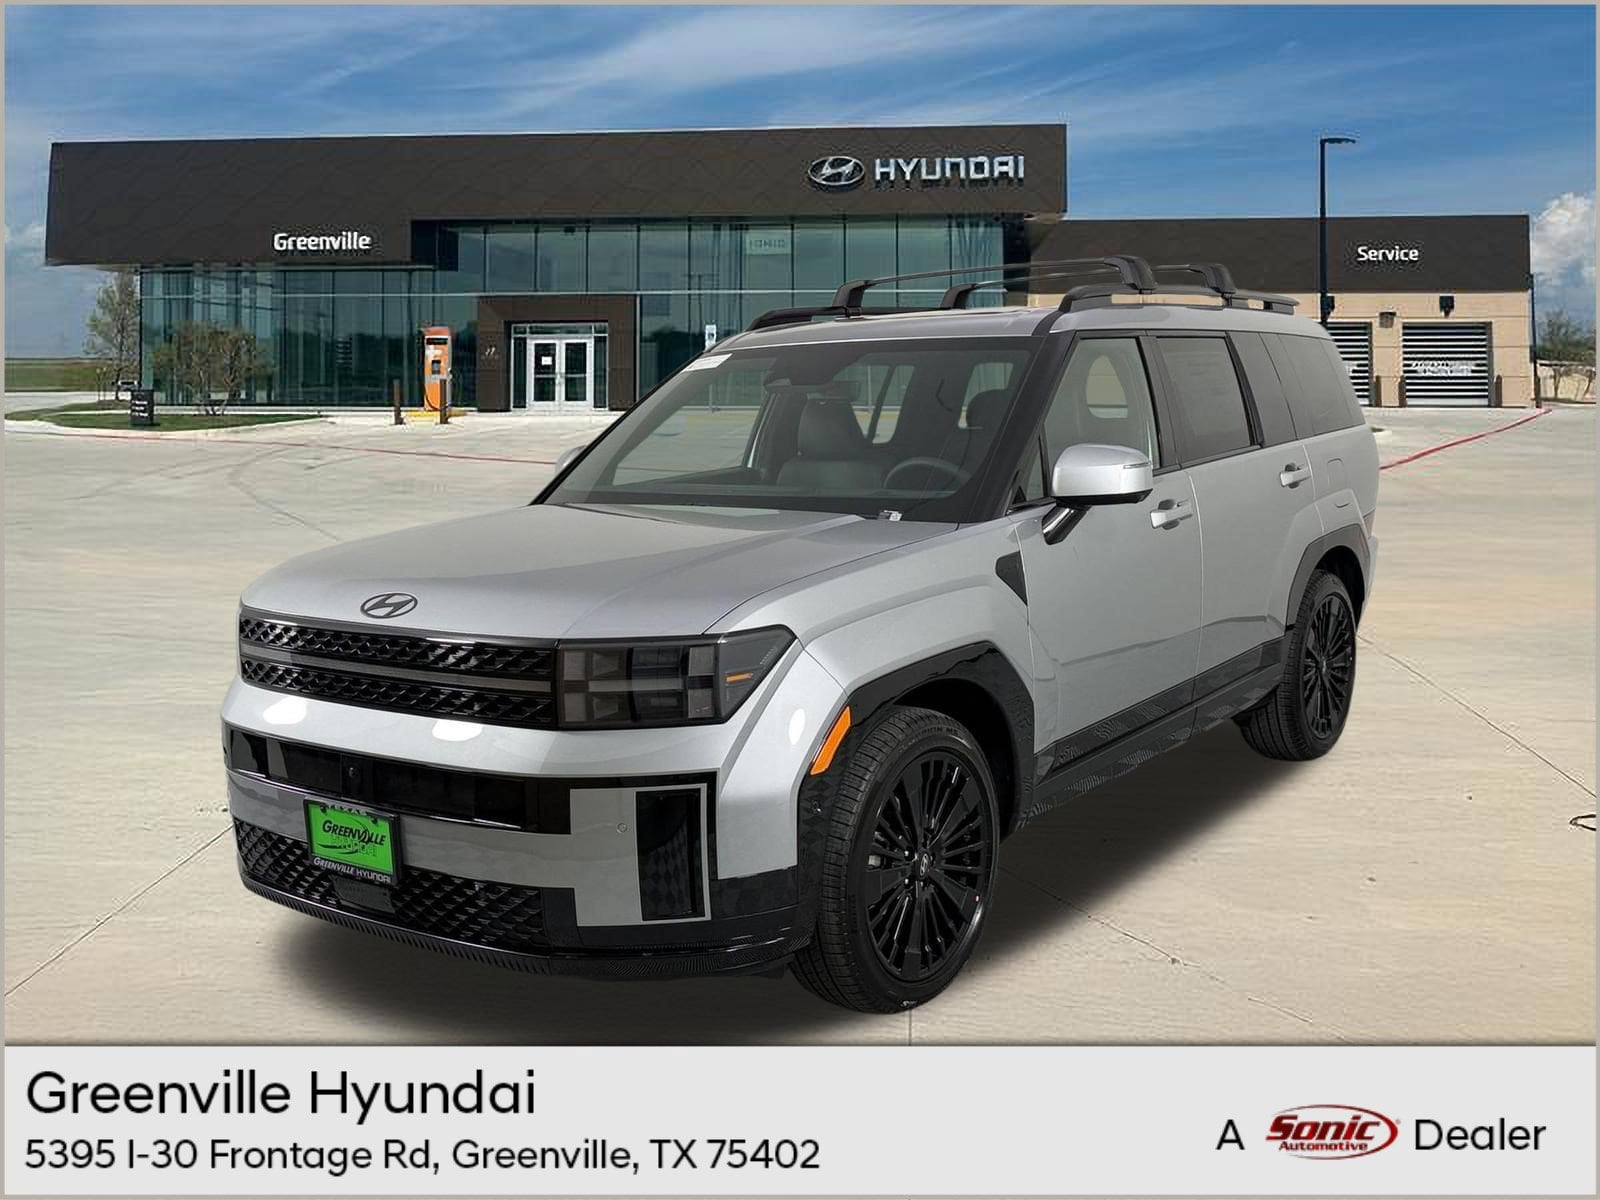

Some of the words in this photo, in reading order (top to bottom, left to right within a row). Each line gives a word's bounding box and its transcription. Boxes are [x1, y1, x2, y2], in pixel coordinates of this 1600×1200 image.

[875, 155, 1025, 181] HYUNDAI
[273, 231, 371, 251] Greenville
[1357, 245, 1420, 261] Service
[322, 820, 386, 846] GREENVILLE
[313, 857, 354, 874] GREENVILLE
[355, 868, 392, 884] HYUNDAI
